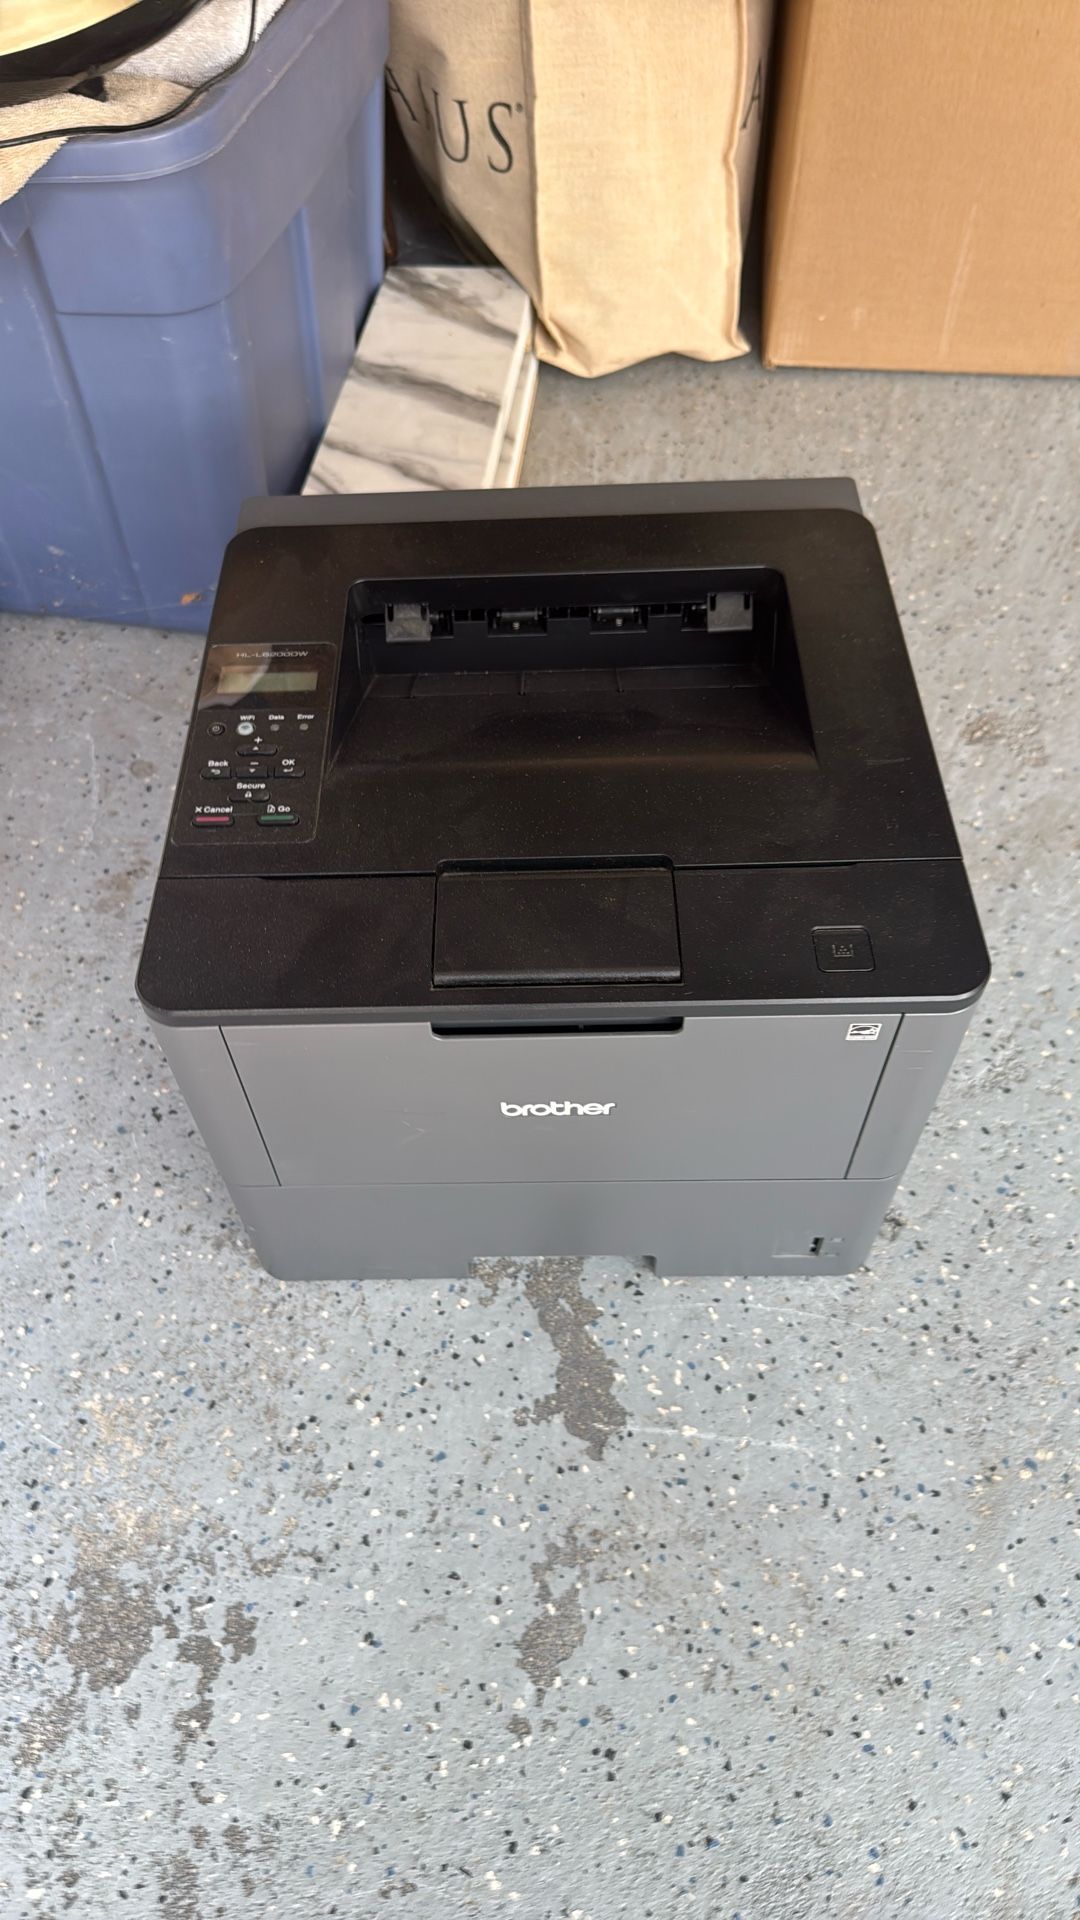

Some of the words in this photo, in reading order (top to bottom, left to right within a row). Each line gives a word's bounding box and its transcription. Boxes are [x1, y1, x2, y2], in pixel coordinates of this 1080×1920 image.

[236, 782, 266, 790] Secure
[277, 805, 291, 813] Go
[500, 1101, 616, 1117] brother
